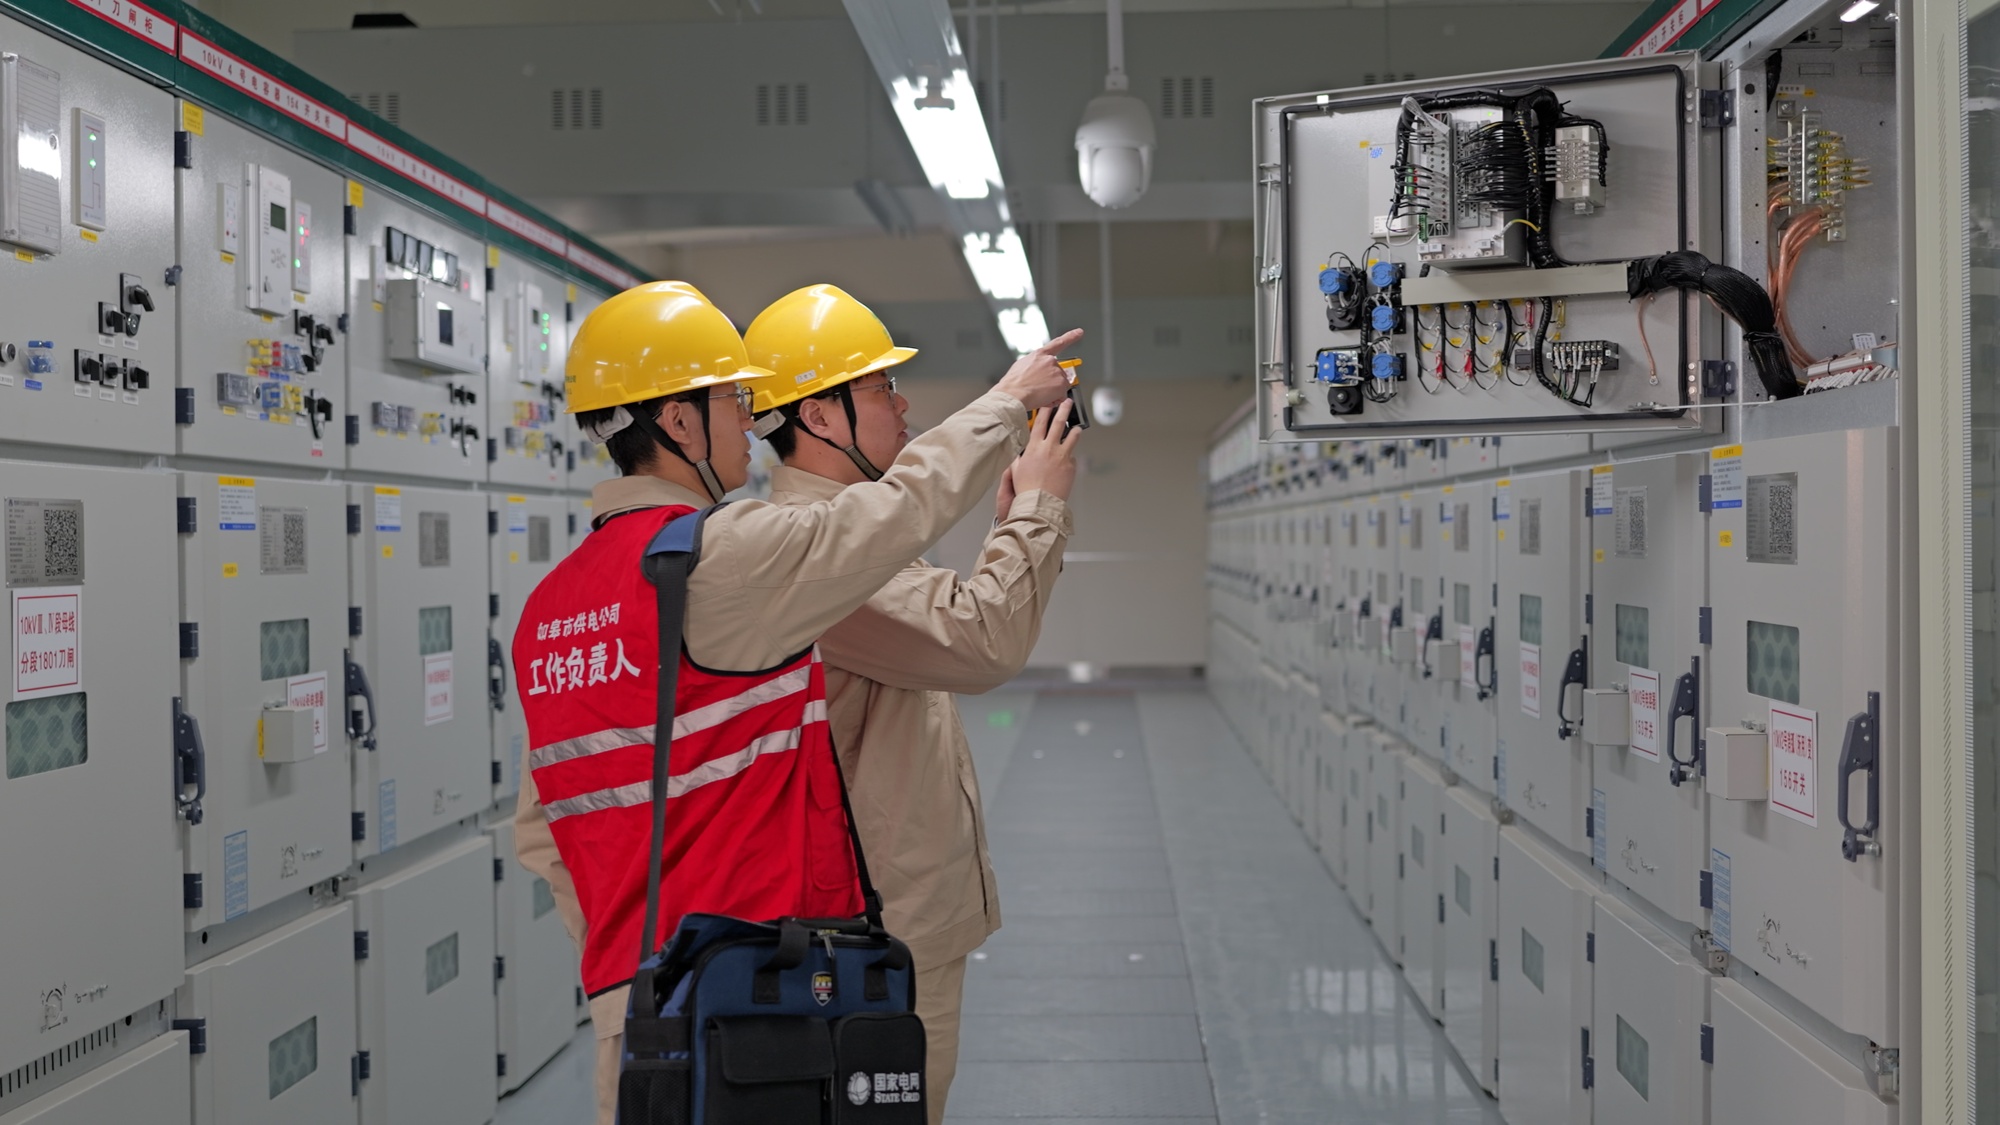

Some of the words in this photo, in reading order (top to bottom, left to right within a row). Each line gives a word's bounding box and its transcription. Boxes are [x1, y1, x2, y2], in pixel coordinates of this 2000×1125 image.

[90, 0, 153, 34] 刀闸柜
[536, 602, 621, 641] 如皋市供电公司
[21, 648, 74, 673] 分段1801刀闸
[528, 638, 642, 696] 工作负责人
[1780, 768, 1805, 796] 156开关
[874, 1072, 919, 1091] 国家电网
